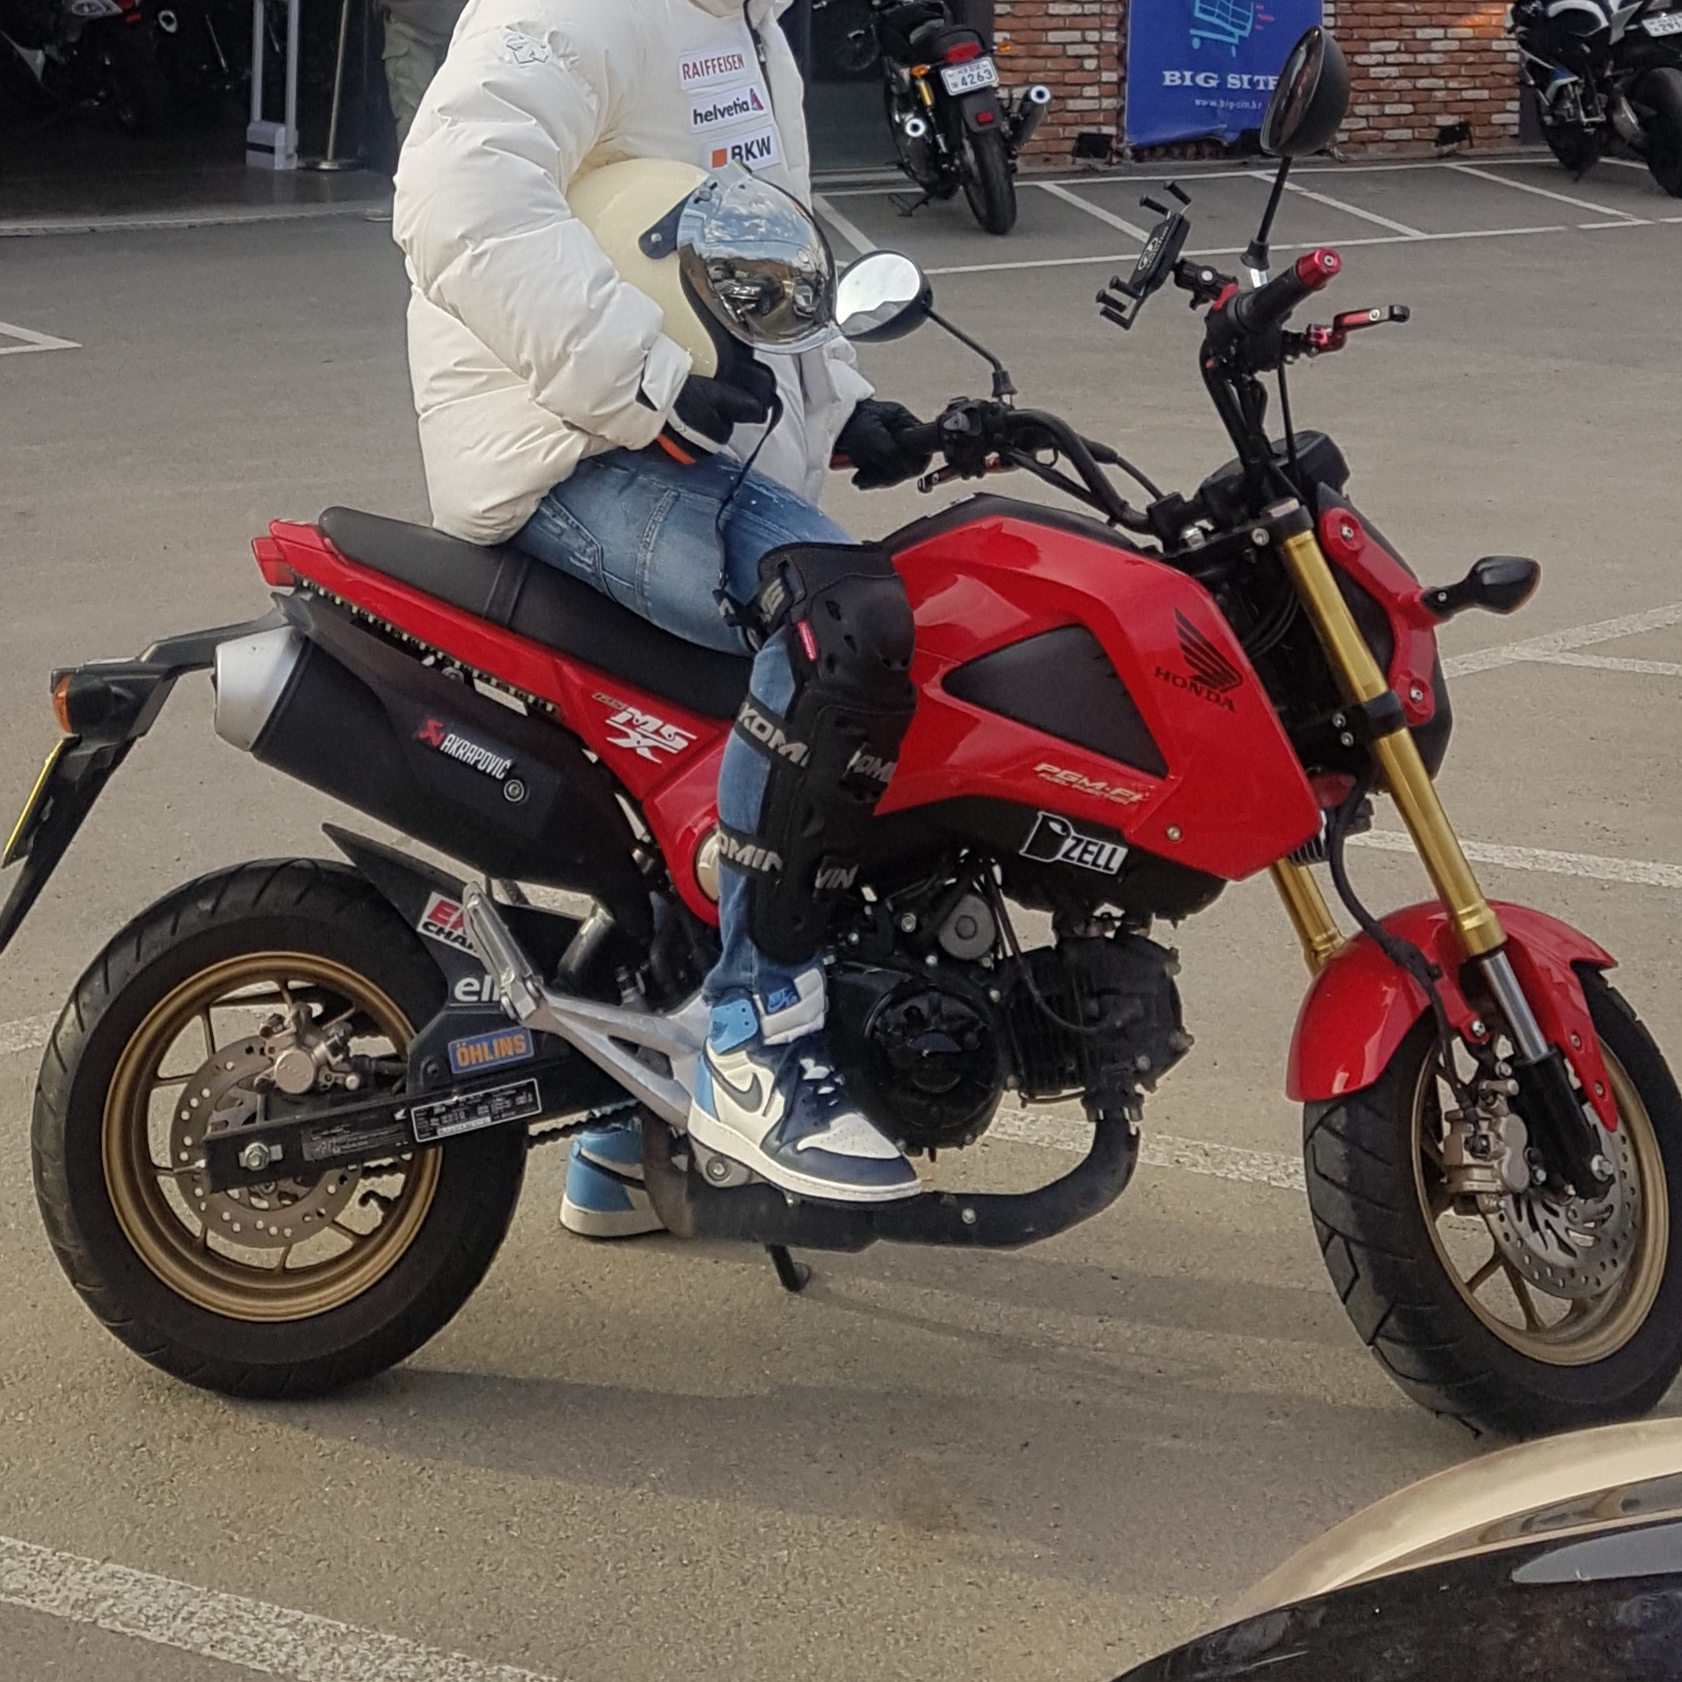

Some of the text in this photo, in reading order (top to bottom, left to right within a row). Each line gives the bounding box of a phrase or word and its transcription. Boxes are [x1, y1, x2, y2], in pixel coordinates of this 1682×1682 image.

[682, 53, 745, 81] RAIFFEISEN
[960, 69, 993, 88] 4263
[1162, 70, 1220, 88] BIG
[692, 97, 750, 125] helvetia
[731, 135, 771, 162] BKW
[1154, 666, 1235, 713] HONDA
[455, 1034, 527, 1068] ÖHLINS
